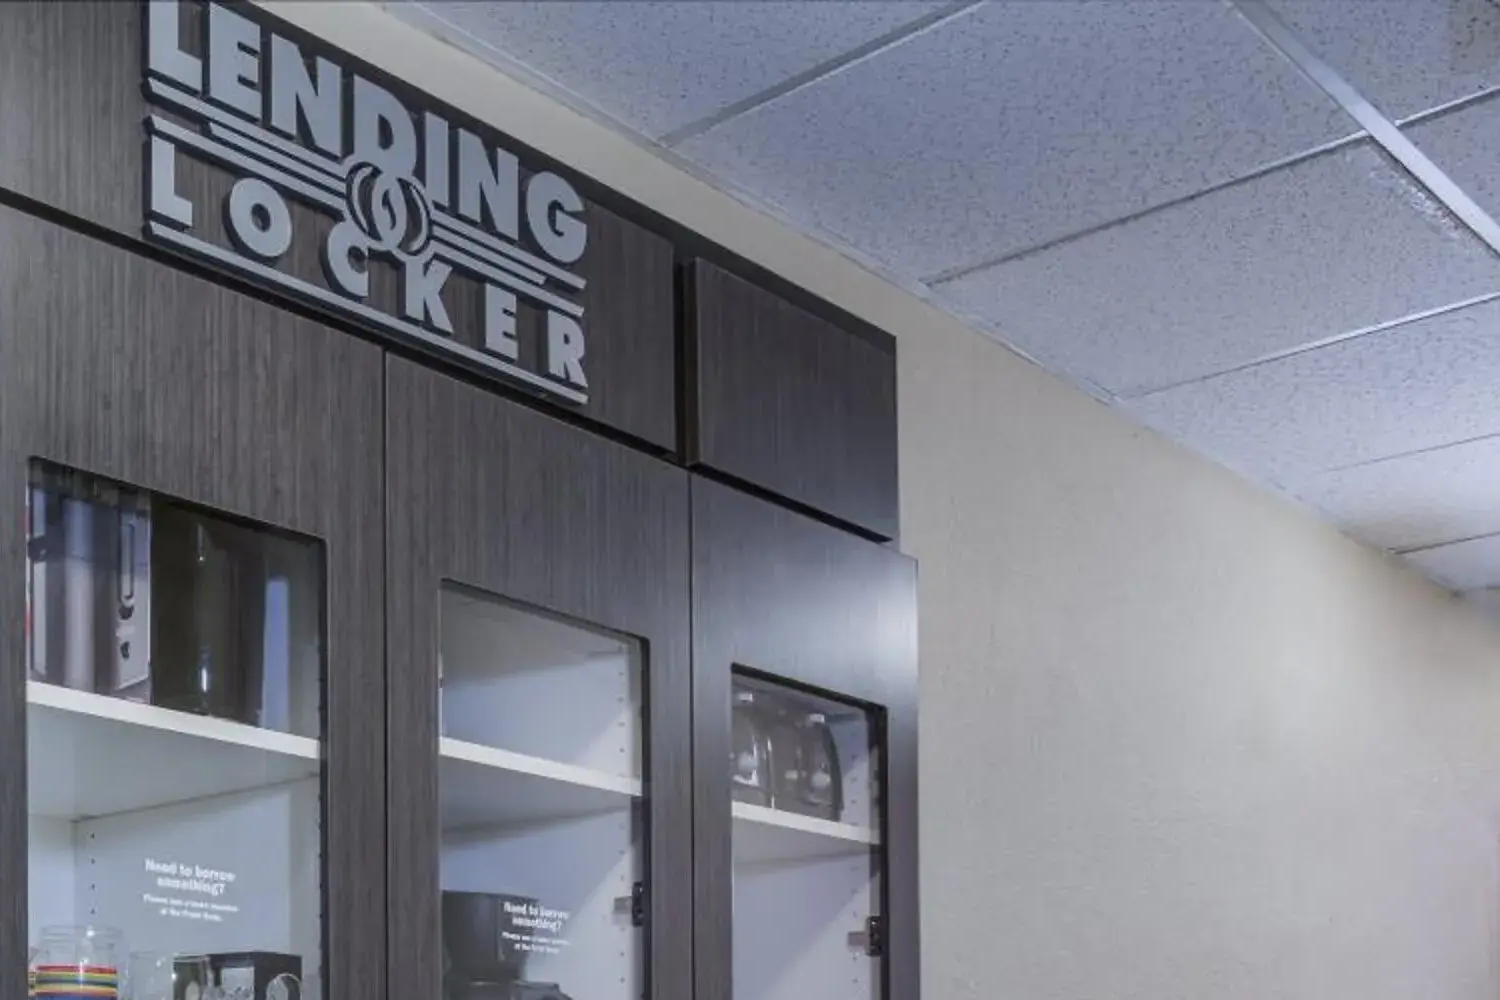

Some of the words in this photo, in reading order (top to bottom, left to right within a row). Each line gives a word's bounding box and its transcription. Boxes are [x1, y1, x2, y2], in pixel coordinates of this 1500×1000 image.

[148, 0, 588, 263] LENDING
[150, 135, 588, 388] LOCKER
[158, 877, 226, 897] something?
